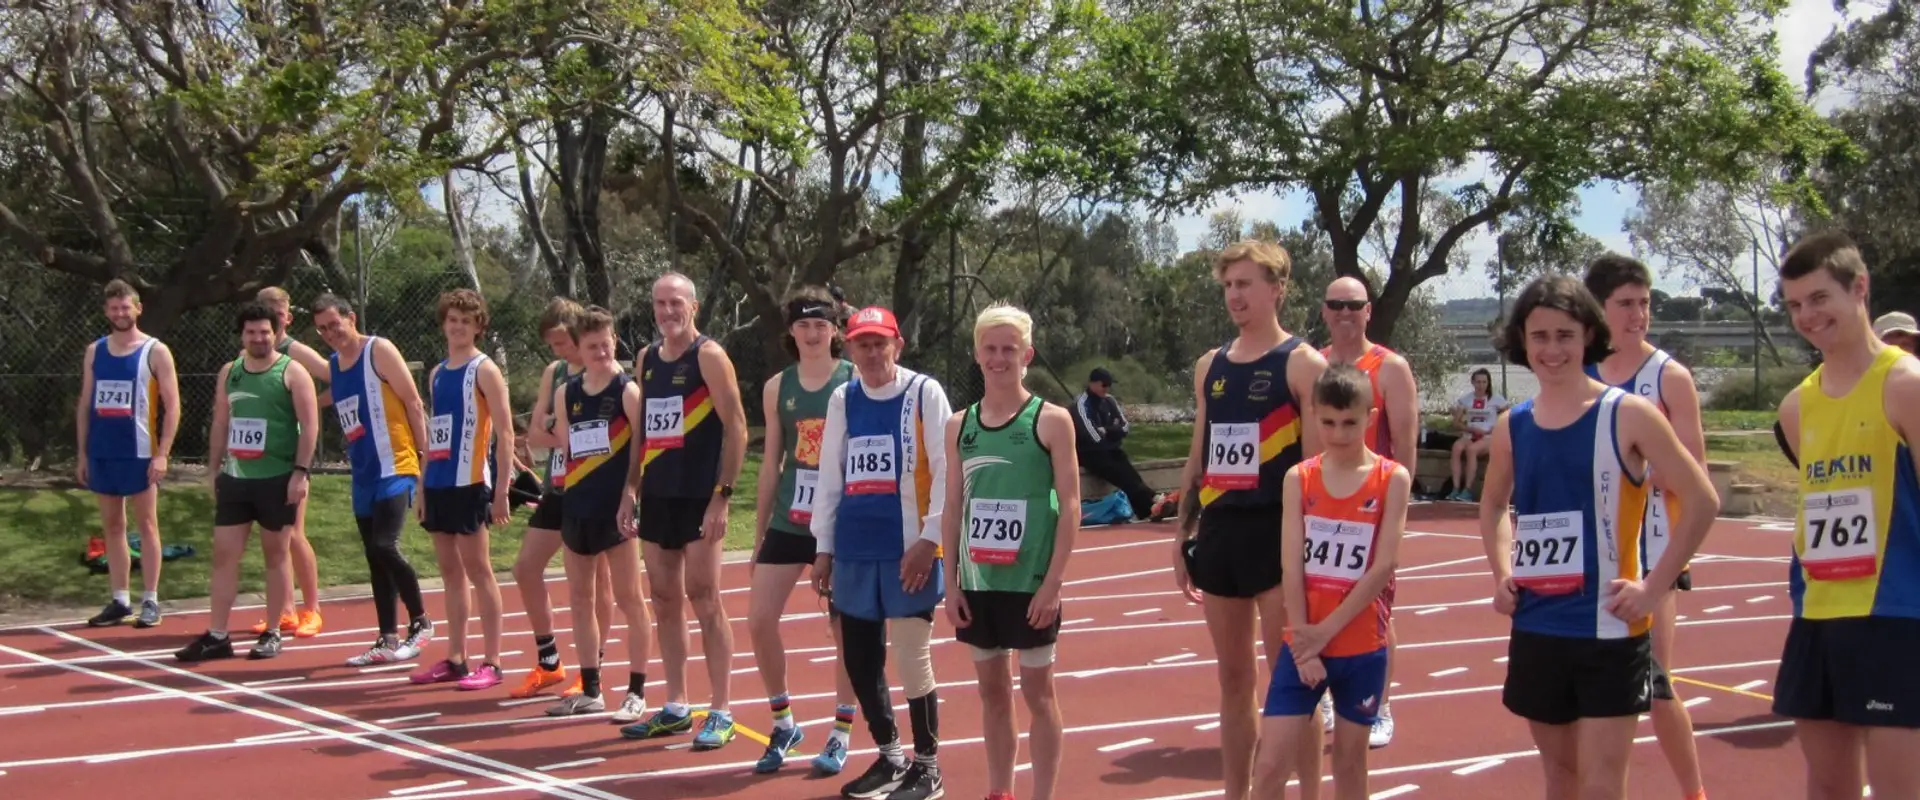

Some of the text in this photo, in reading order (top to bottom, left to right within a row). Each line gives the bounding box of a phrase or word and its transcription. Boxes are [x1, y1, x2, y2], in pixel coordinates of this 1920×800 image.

[98, 391, 131, 404] 3741
[463, 366, 476, 463] CHILWELL
[231, 430, 263, 445] 1169
[903, 398, 914, 473] CHILWELL
[851, 452, 892, 474] 1485
[1211, 442, 1255, 466] 1969
[798, 485, 814, 504] 11
[971, 517, 1023, 541] 2730
[1809, 514, 1868, 549] 762
[1304, 538, 1366, 569] 3415
[1515, 536, 1578, 567] 2927
